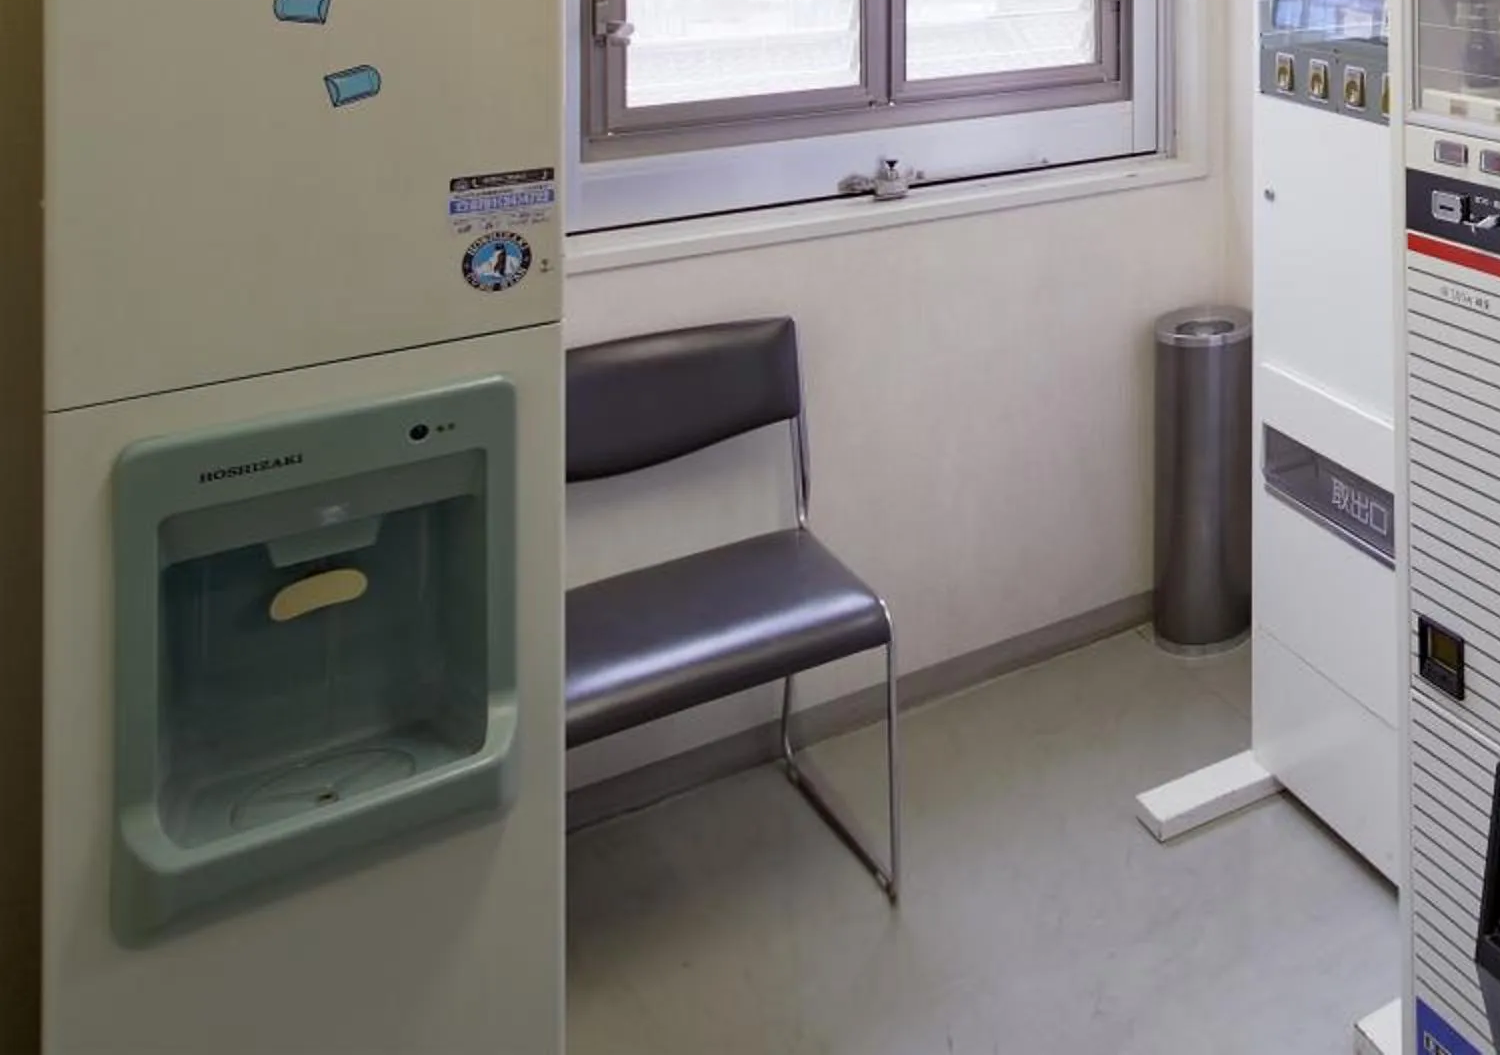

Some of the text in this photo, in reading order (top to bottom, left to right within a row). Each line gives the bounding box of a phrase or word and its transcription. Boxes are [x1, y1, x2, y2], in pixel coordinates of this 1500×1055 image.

[199, 453, 304, 485] HOSHIZAKI
[1330, 476, 1389, 537] 取出口
